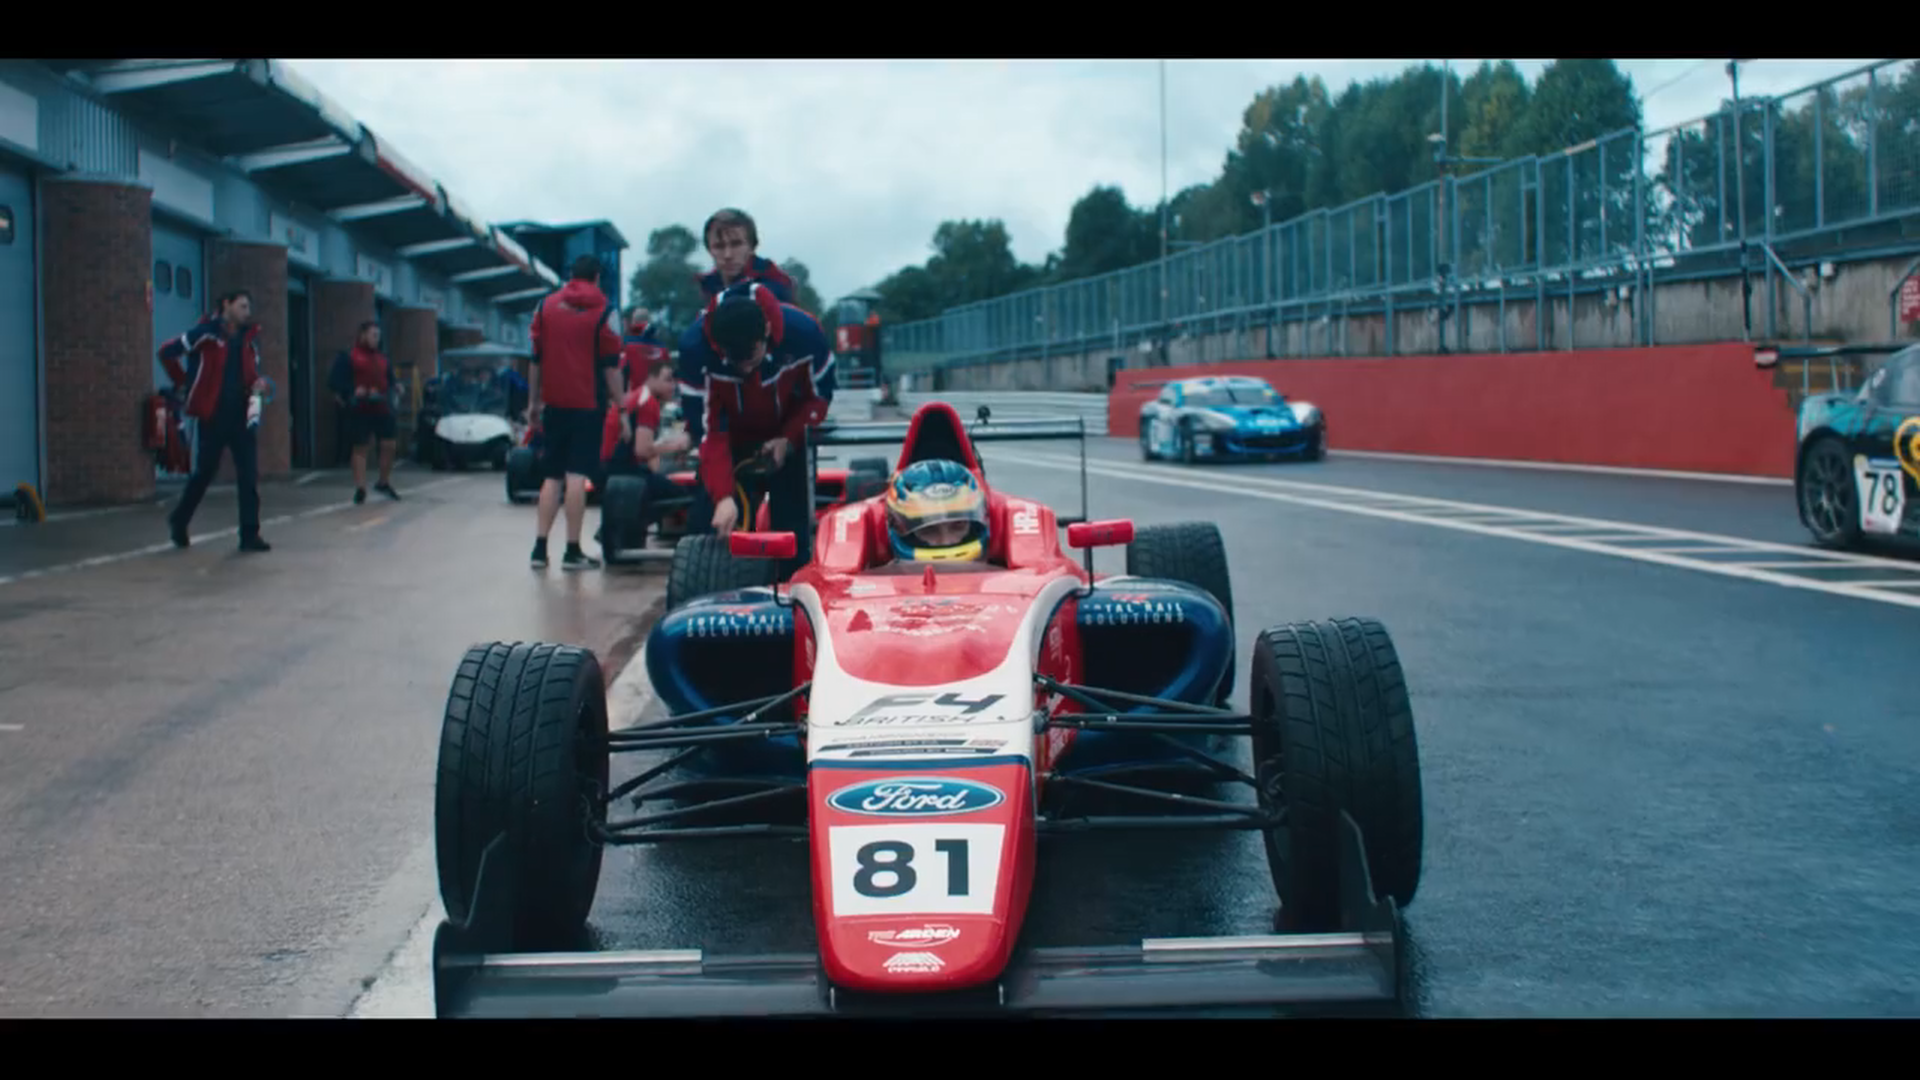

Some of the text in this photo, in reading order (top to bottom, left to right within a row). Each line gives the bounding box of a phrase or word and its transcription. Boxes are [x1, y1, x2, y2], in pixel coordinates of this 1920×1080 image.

[1864, 473, 1898, 515] 78
[686, 623, 785, 637] SOLUTIONS
[1085, 612, 1184, 625] SOLUTIONS
[862, 783, 968, 811] Ford
[853, 838, 969, 898] 81
